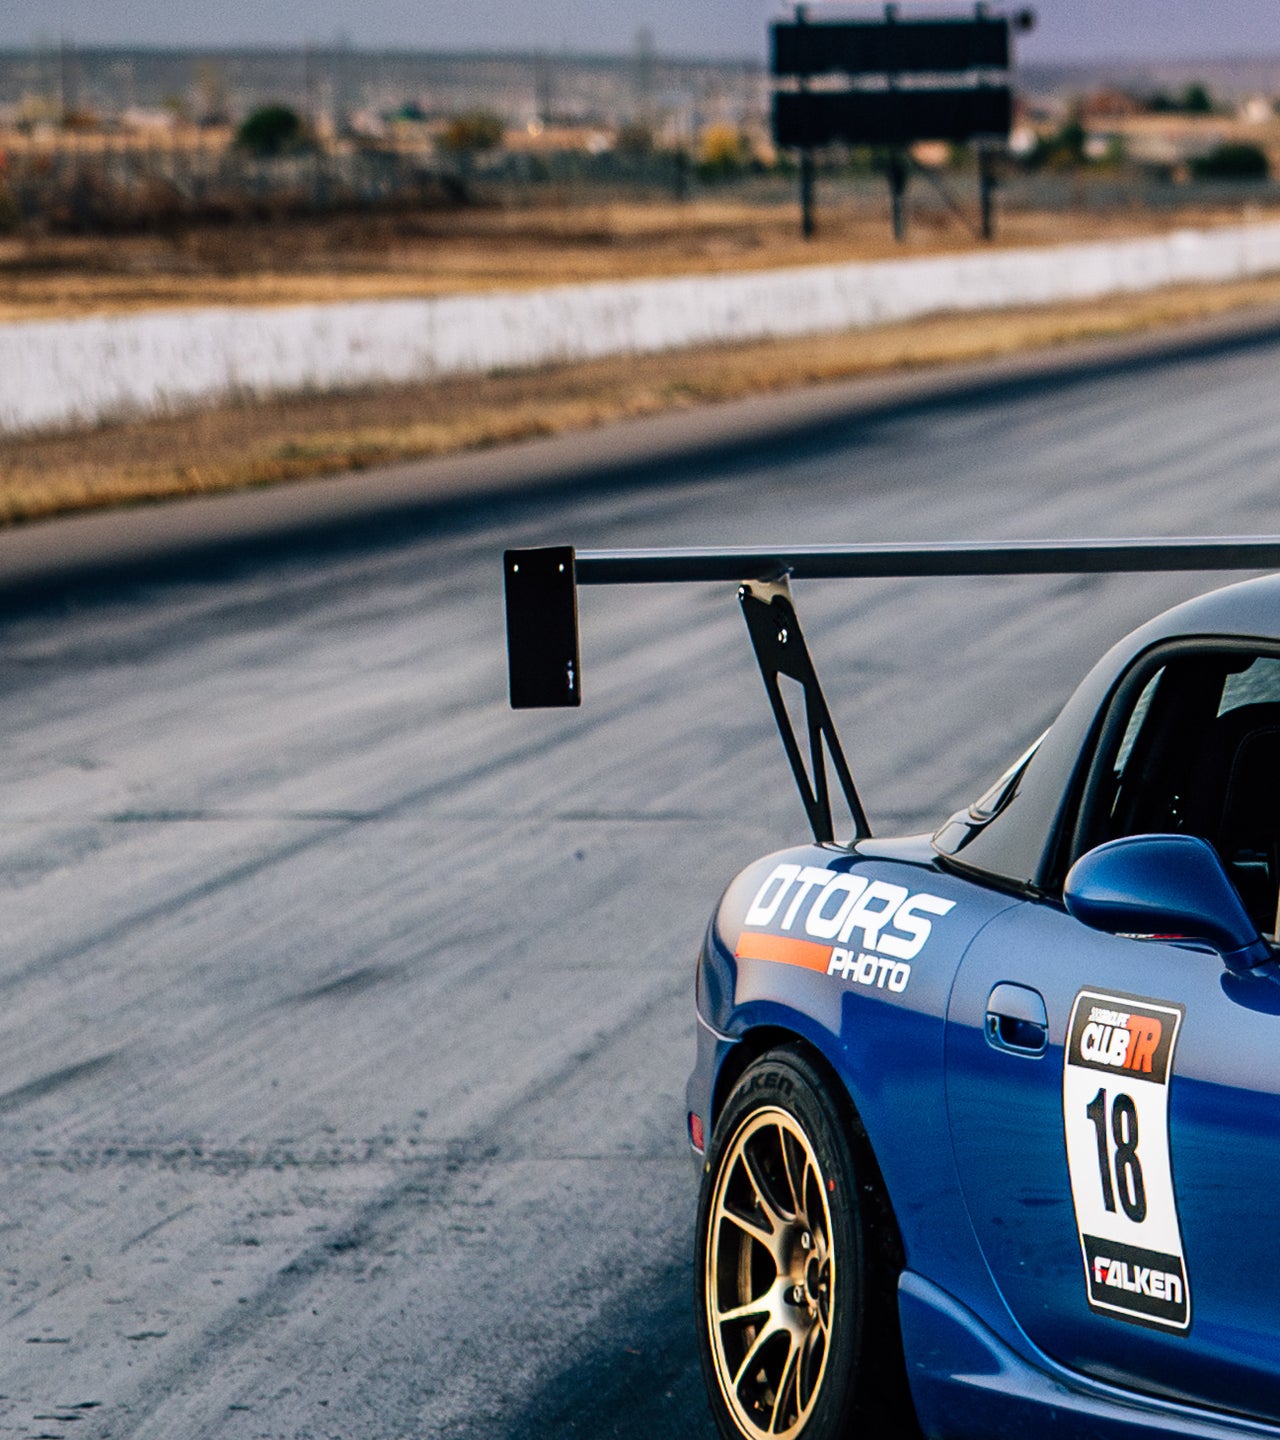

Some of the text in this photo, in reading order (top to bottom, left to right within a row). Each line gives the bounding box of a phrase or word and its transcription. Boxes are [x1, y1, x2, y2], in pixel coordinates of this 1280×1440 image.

[827, 947, 911, 992] PHOTO
[1086, 1087, 1147, 1224] 18
[1092, 1256, 1182, 1304] FALKEN
